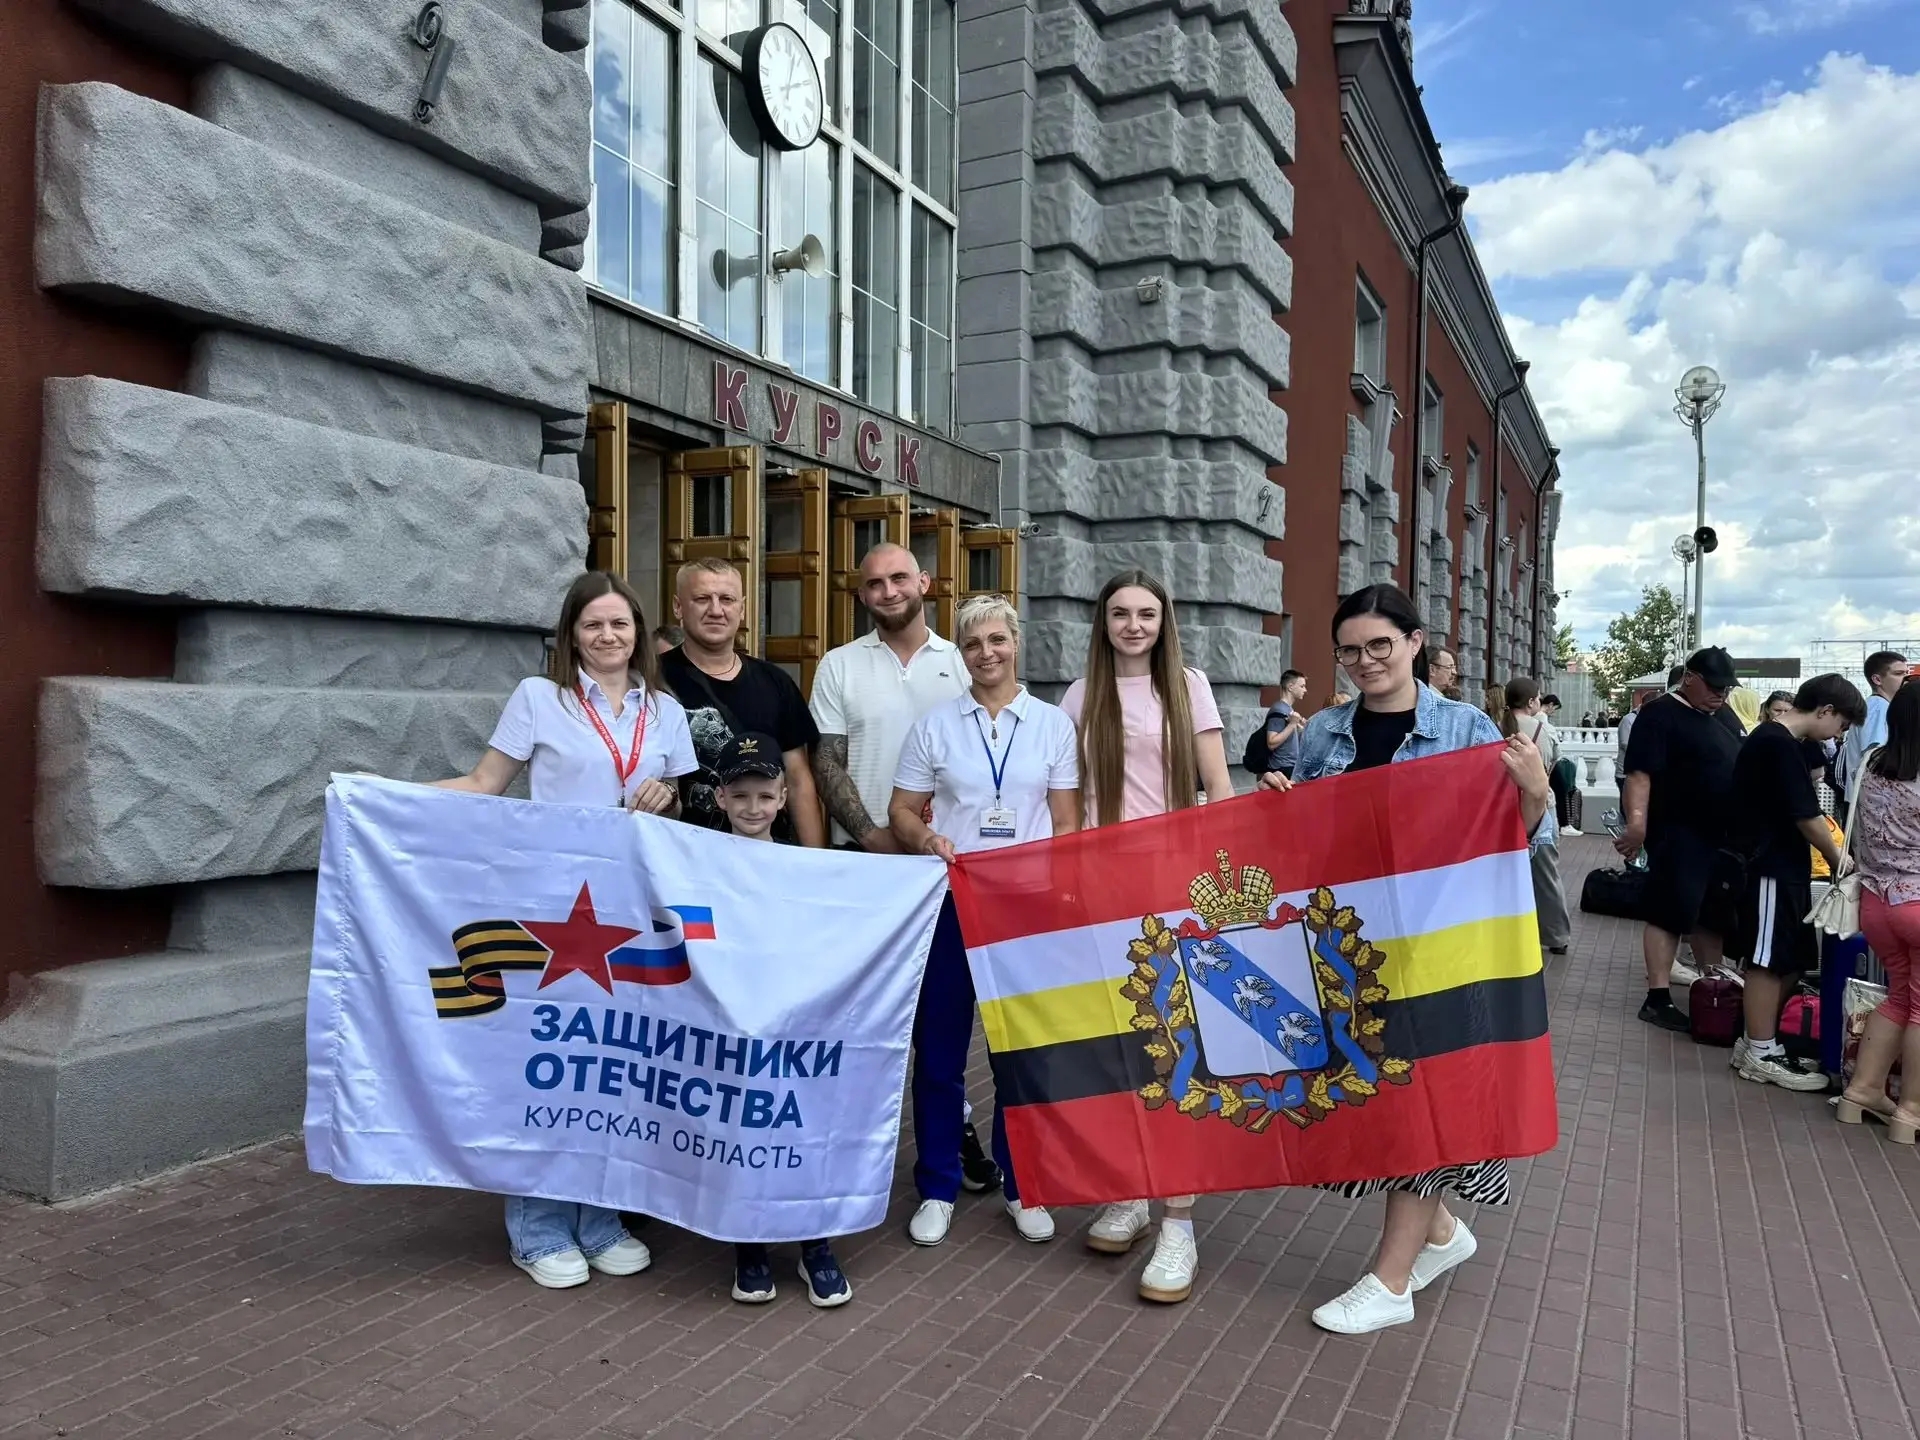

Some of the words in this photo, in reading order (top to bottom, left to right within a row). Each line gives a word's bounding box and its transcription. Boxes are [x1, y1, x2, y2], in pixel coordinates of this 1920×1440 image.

[713, 360, 921, 487] КУРСК
[530, 1003, 844, 1079] ЗАЩИТНИКИ
[525, 1052, 803, 1130] ОТЕЧЕСТВА
[524, 1105, 661, 1145] КУРСКАЯ
[673, 1130, 803, 1169] ОБЛАСТЬ
